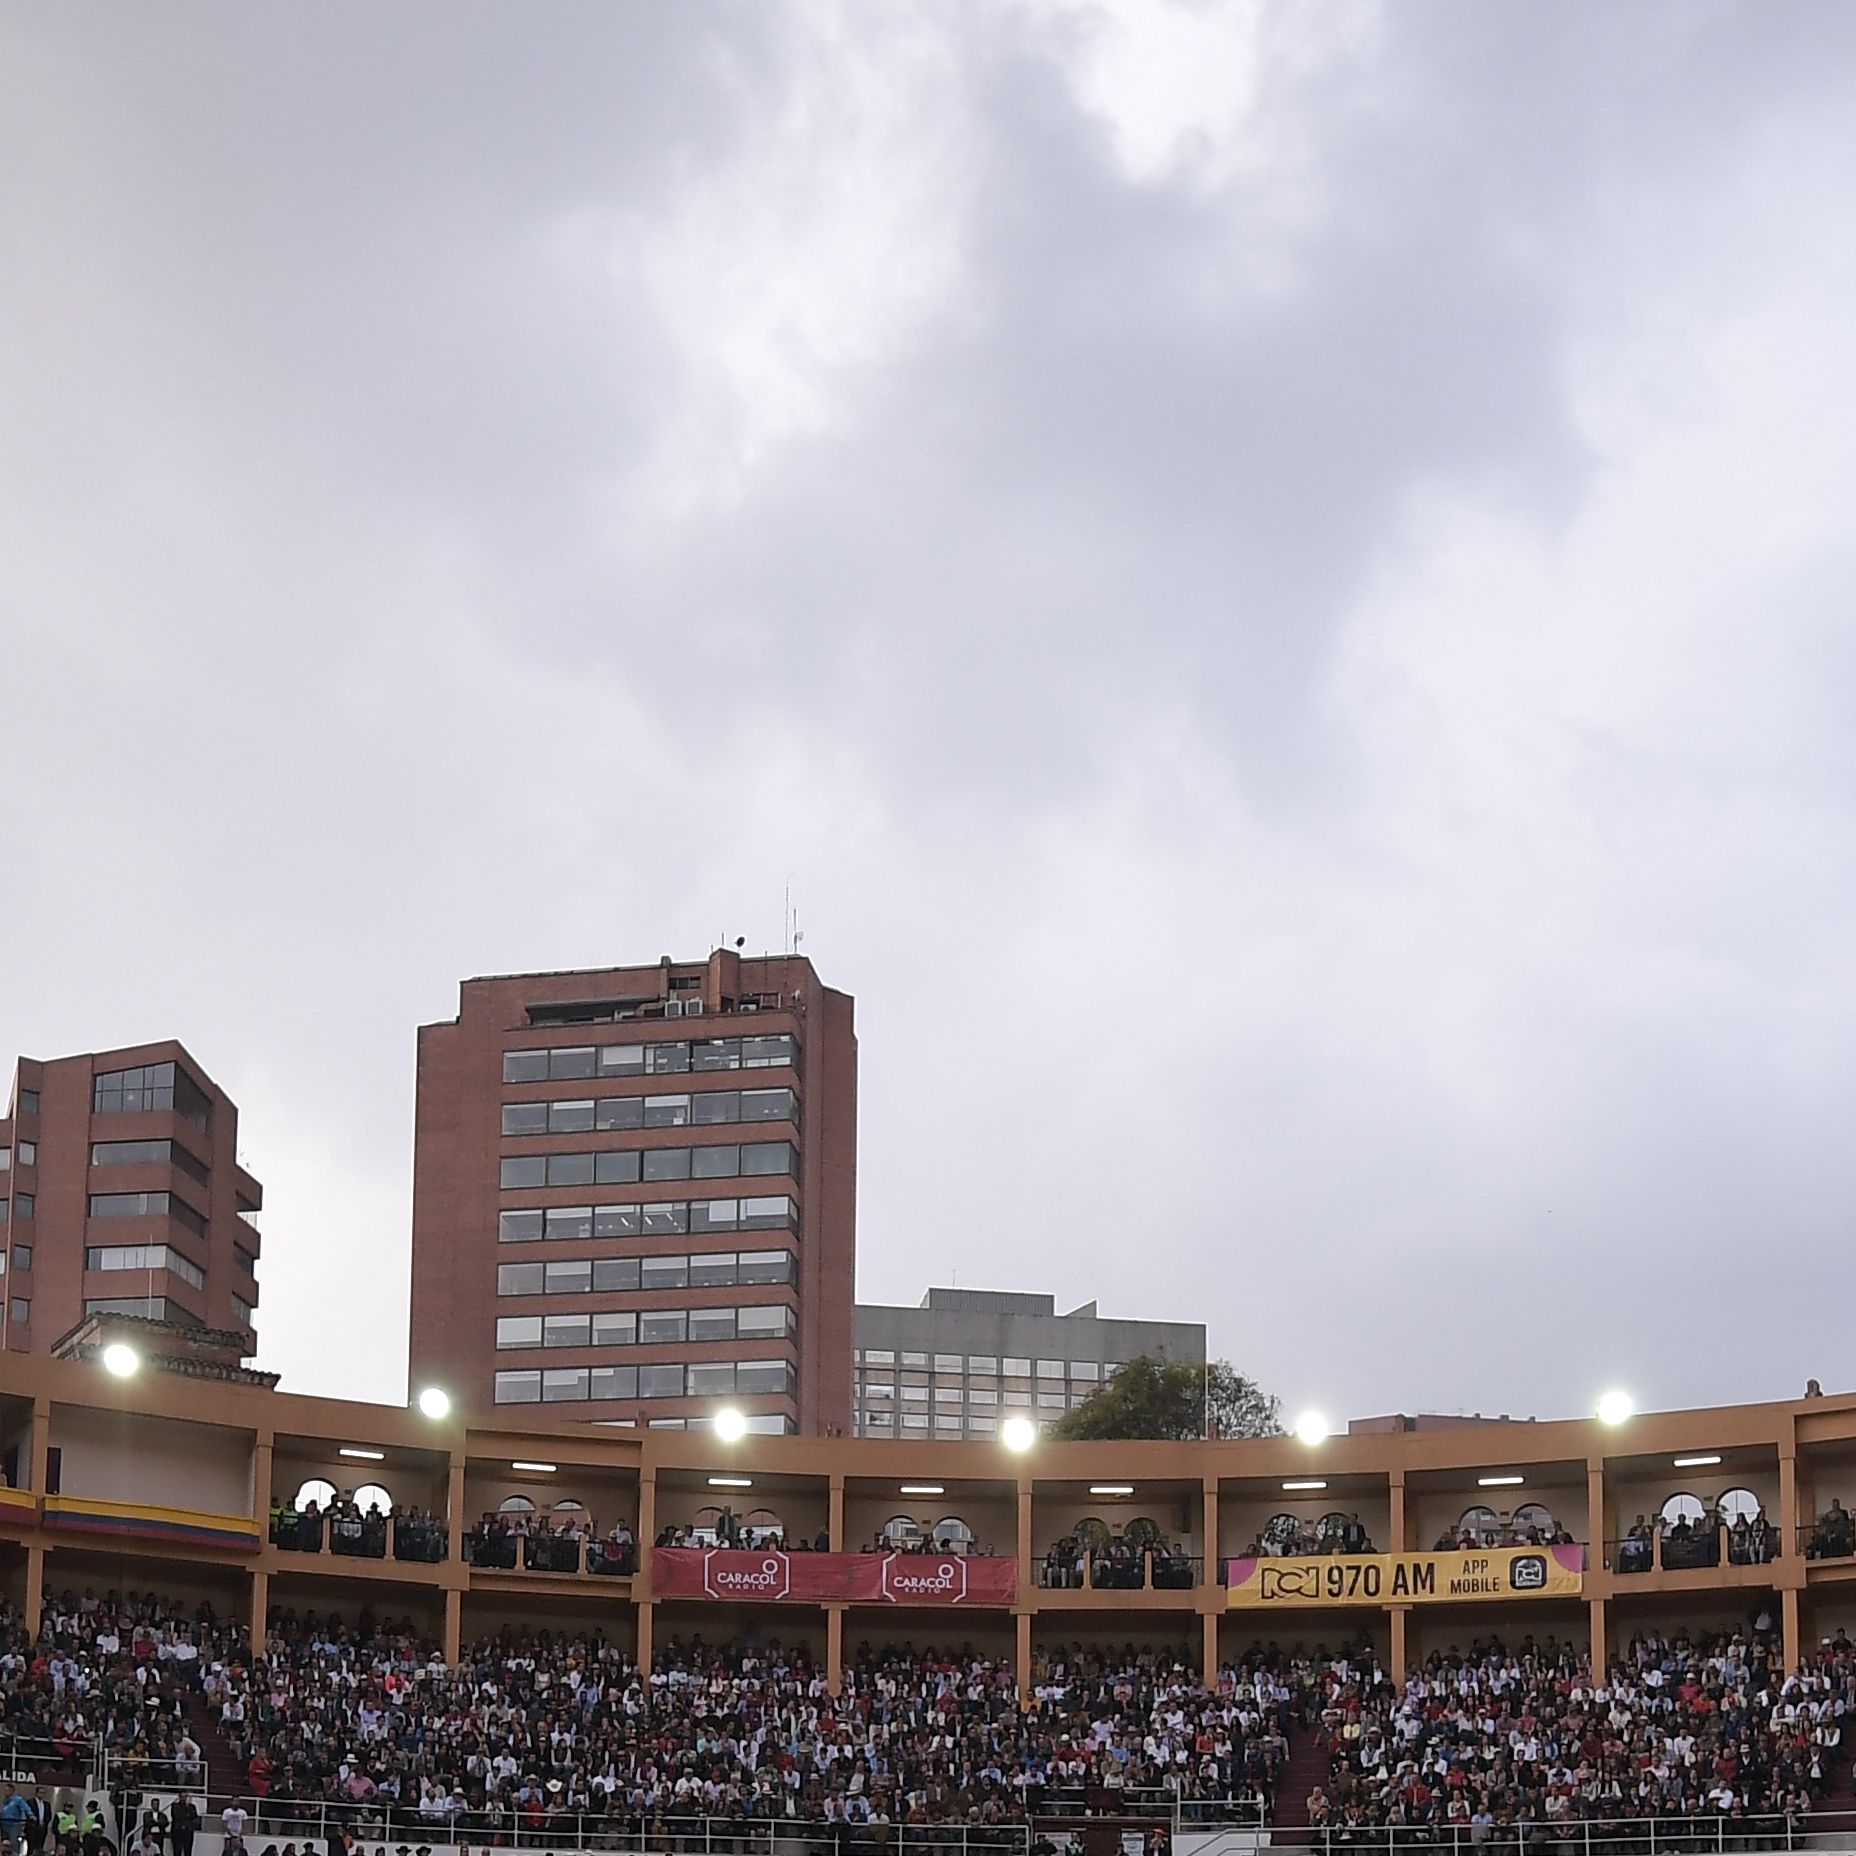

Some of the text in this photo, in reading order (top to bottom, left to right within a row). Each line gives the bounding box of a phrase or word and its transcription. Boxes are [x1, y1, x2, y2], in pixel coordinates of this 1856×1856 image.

[1463, 1559, 1489, 1574] APP
[717, 1572, 776, 1585] CARACOL
[894, 1576, 952, 1588] CARACOL
[1327, 1564, 1381, 1598] 970
[1391, 1562, 1435, 1596] AM
[1450, 1576, 1500, 1594] MOBILE
